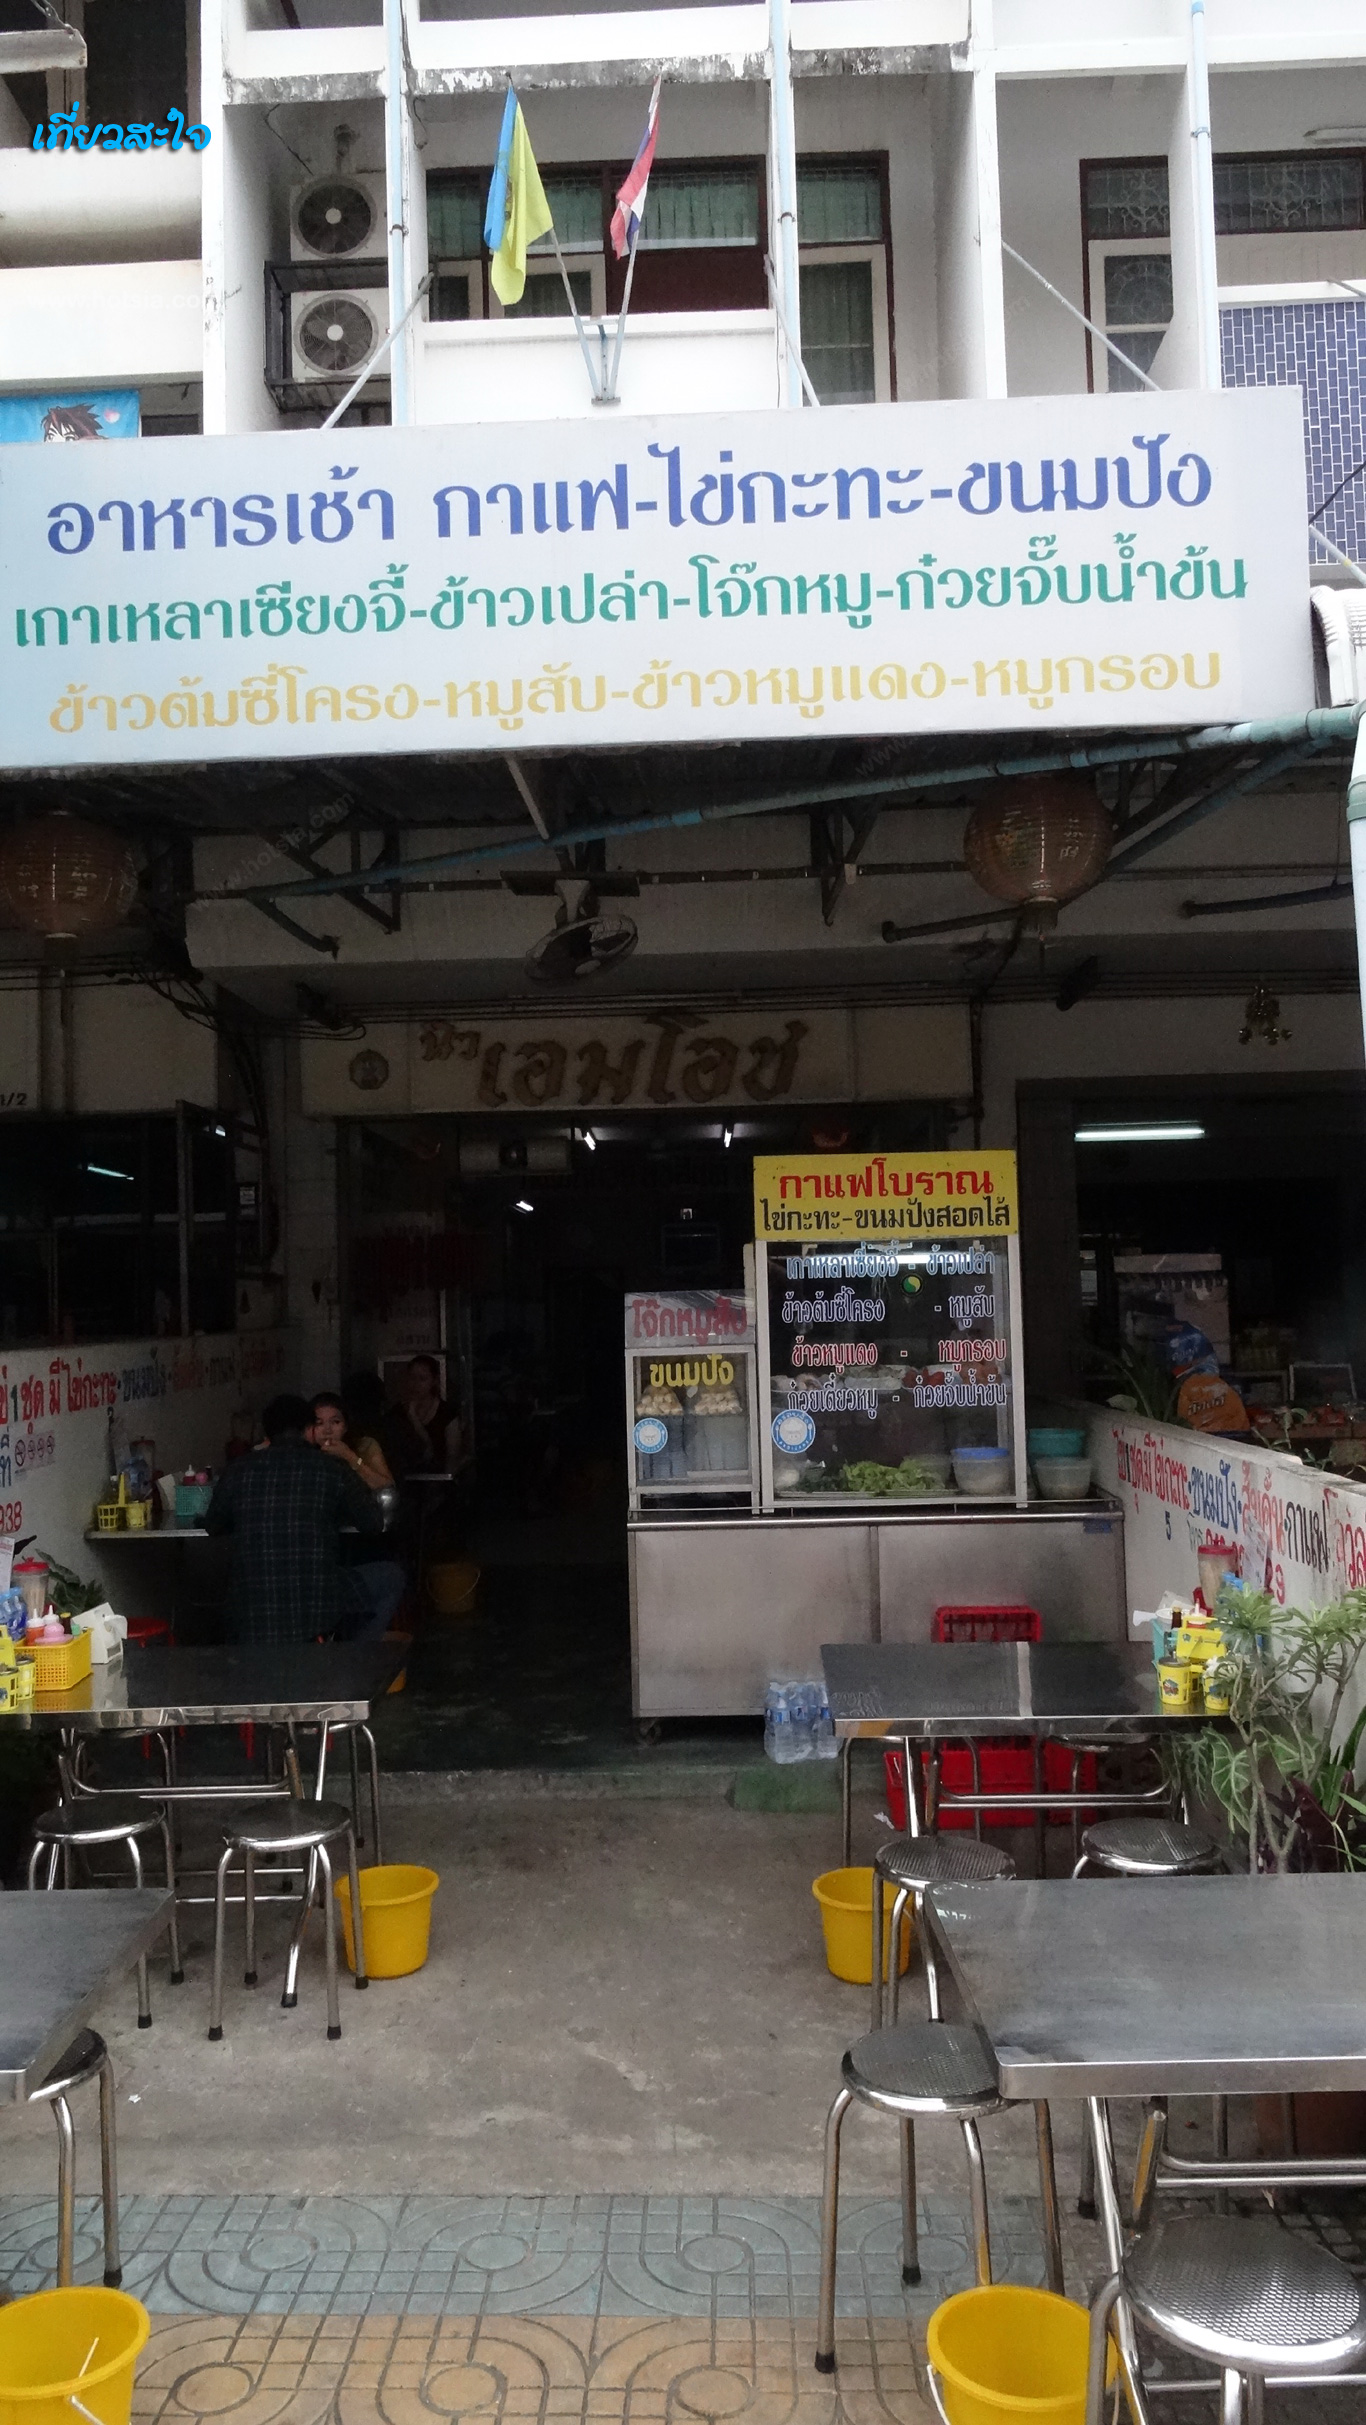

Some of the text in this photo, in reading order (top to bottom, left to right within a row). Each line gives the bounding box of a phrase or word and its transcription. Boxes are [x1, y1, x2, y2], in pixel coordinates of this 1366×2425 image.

[48, 465, 395, 554] อาหารเช้า
[780, 1158, 994, 1199] กาแฟโบราณ
[650, 1353, 734, 1387] ขนมปัง
[792, 1336, 878, 1374] ข้าวหมูแดง
[938, 1339, 1006, 1372] หมูกรอบ
